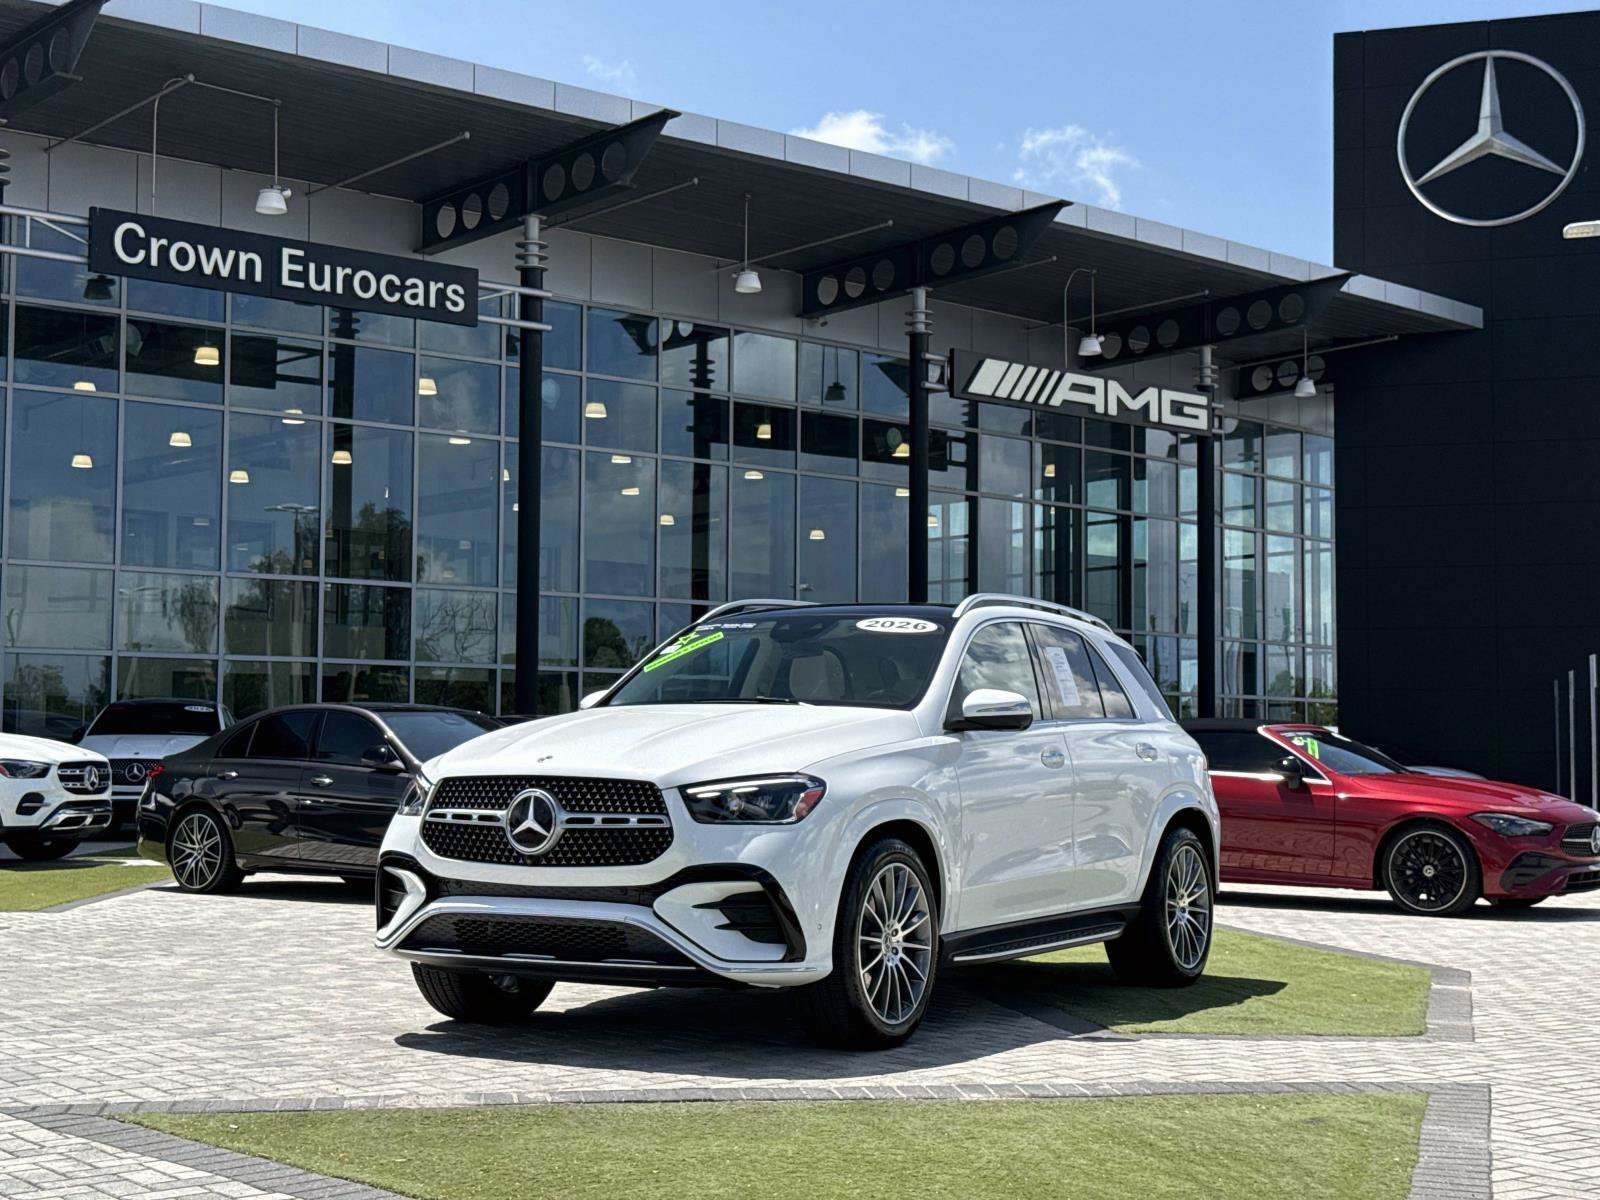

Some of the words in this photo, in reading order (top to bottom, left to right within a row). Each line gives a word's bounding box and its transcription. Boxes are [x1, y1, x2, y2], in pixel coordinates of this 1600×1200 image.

[113, 221, 263, 282] Crown
[281, 247, 465, 312] Eurocars
[1049, 372, 1208, 430] AMG
[864, 620, 928, 631] 2026
